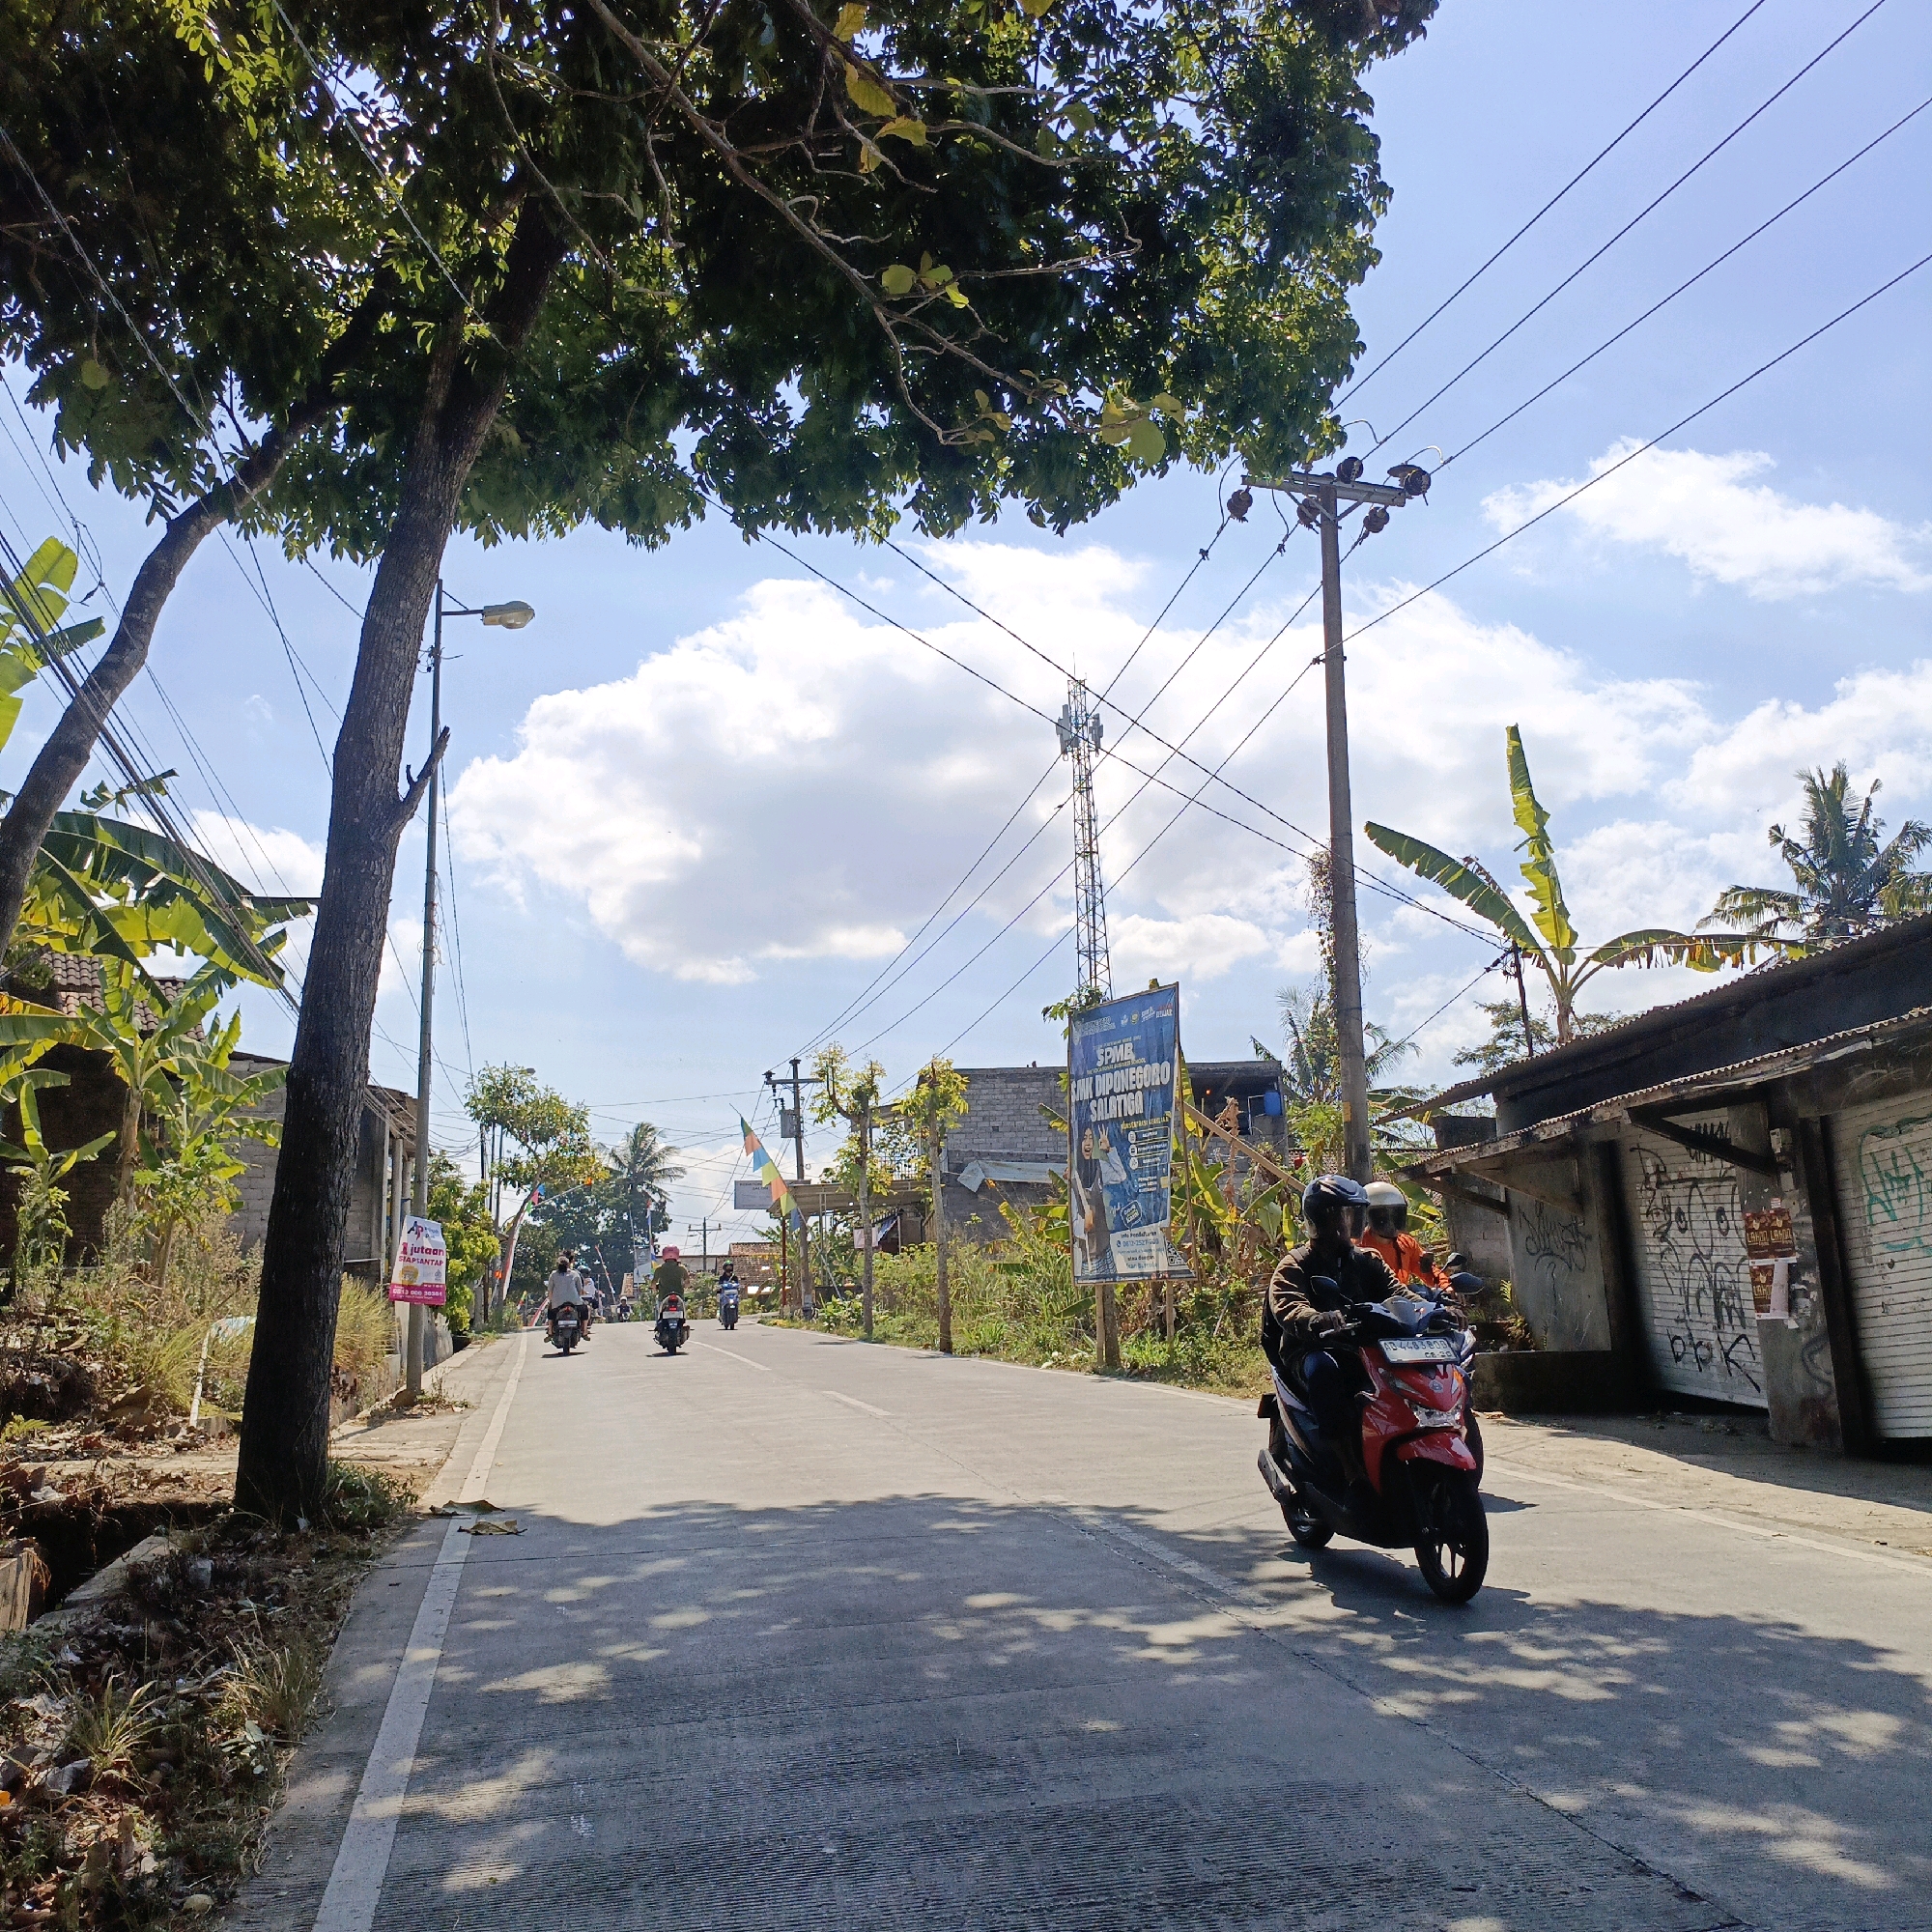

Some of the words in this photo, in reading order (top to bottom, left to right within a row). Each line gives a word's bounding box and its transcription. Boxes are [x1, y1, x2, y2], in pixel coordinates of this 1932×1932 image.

[1096, 1042, 1135, 1066] SPMB
[1071, 1077, 1094, 1102] SMK
[1095, 1061, 1171, 1097] DIPONEGORO
[1090, 1091, 1143, 1122] SALATIGA
[411, 1244, 444, 1257] jutaan
